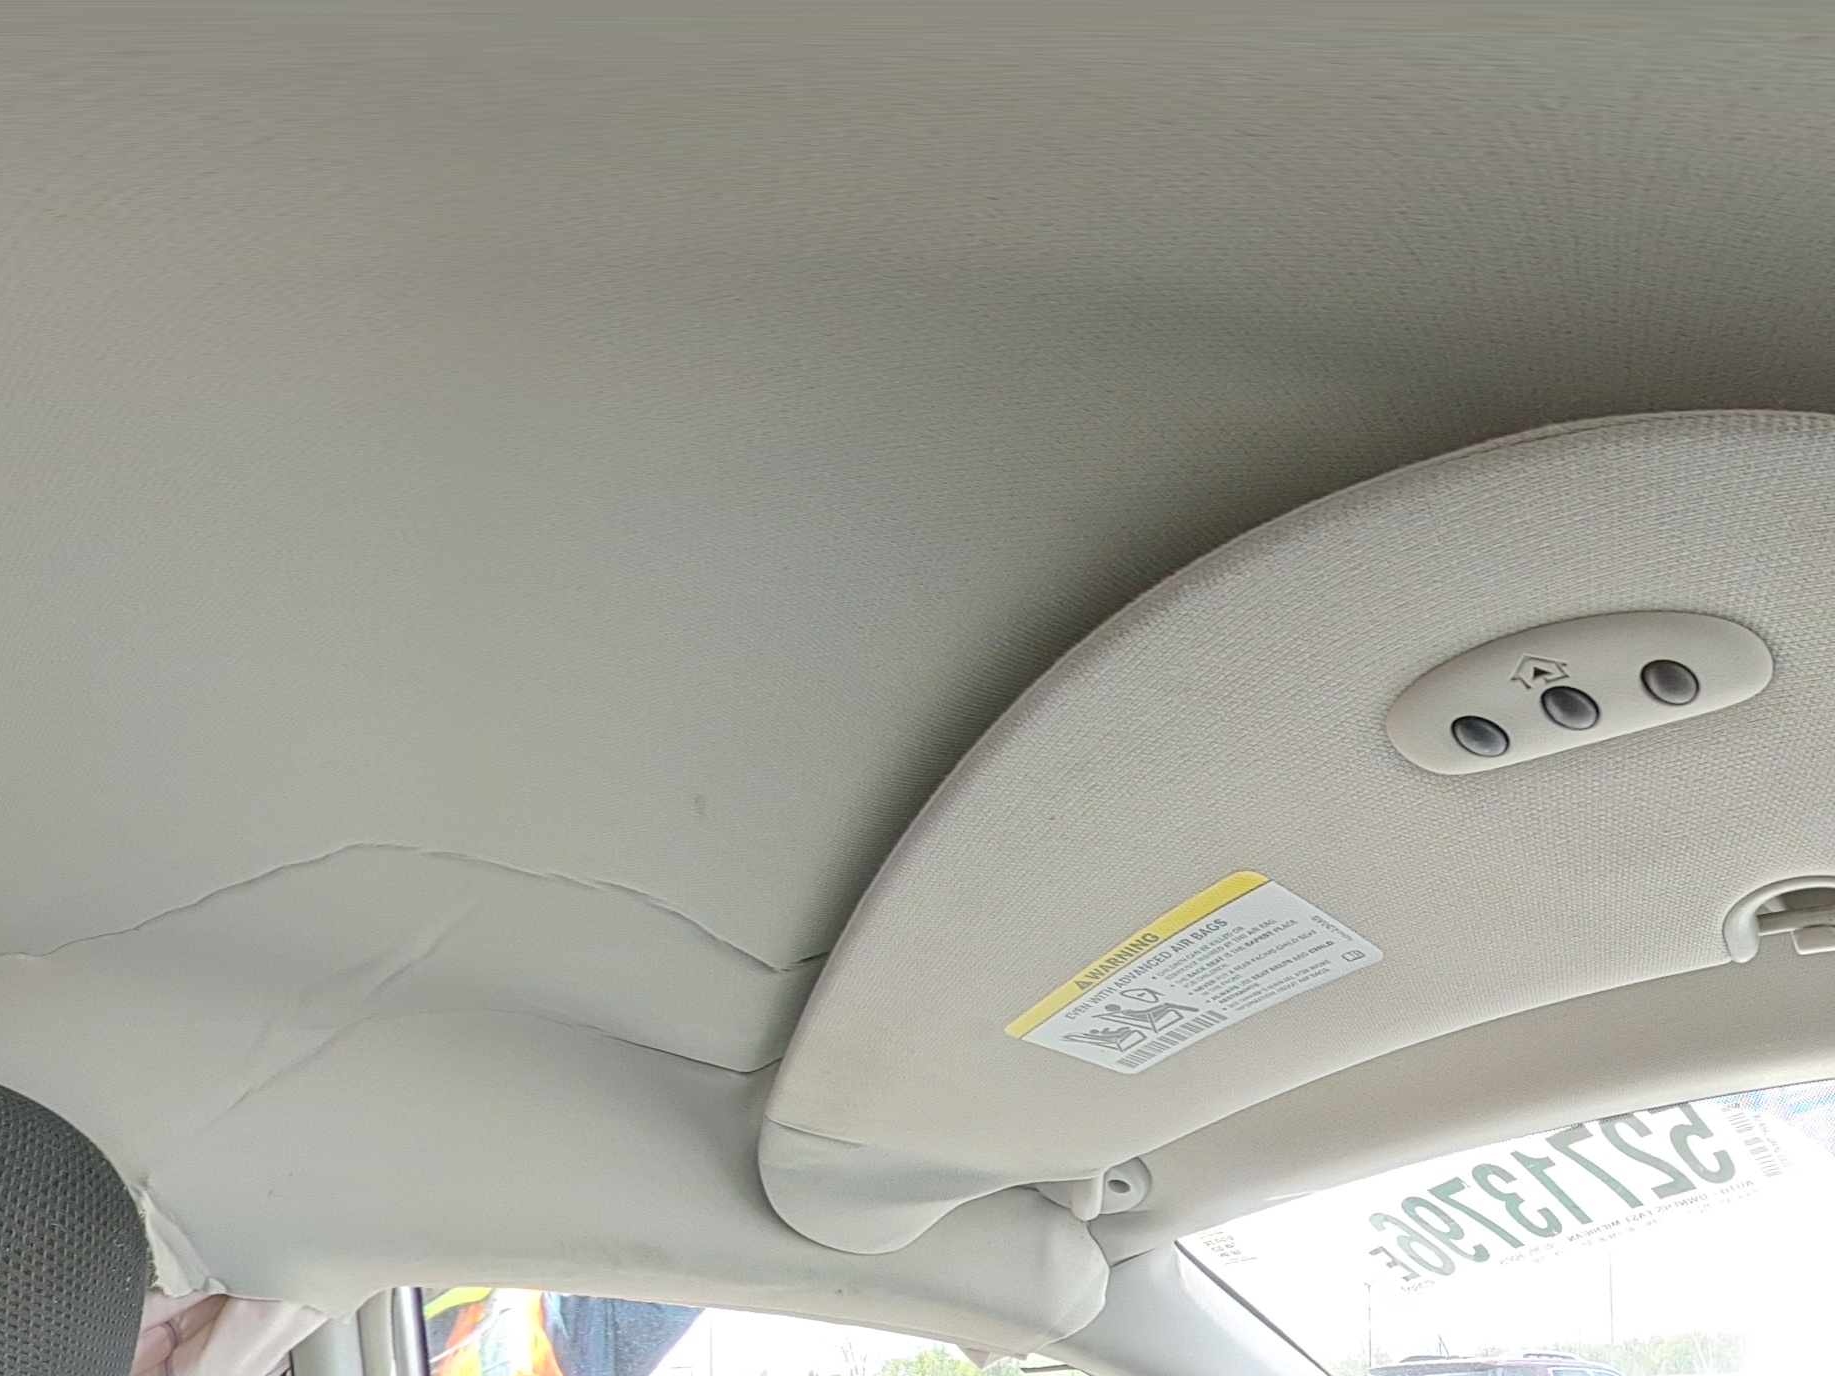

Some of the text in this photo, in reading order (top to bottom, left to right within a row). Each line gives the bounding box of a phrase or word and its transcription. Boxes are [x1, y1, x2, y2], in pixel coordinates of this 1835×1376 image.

[1186, 966, 1208, 978] BACK
[1206, 957, 1226, 967] SEAT
[1272, 919, 1298, 933] PLACE
[1231, 925, 1244, 933] OR
[1065, 918, 1229, 1020] EVEN WITH ADVANCED AIR BAGS
[1085, 933, 1160, 981] WARNING
[1251, 970, 1272, 980] SEAT
[1308, 940, 1335, 954] CHILD
[1192, 979, 1218, 992] NEVER
